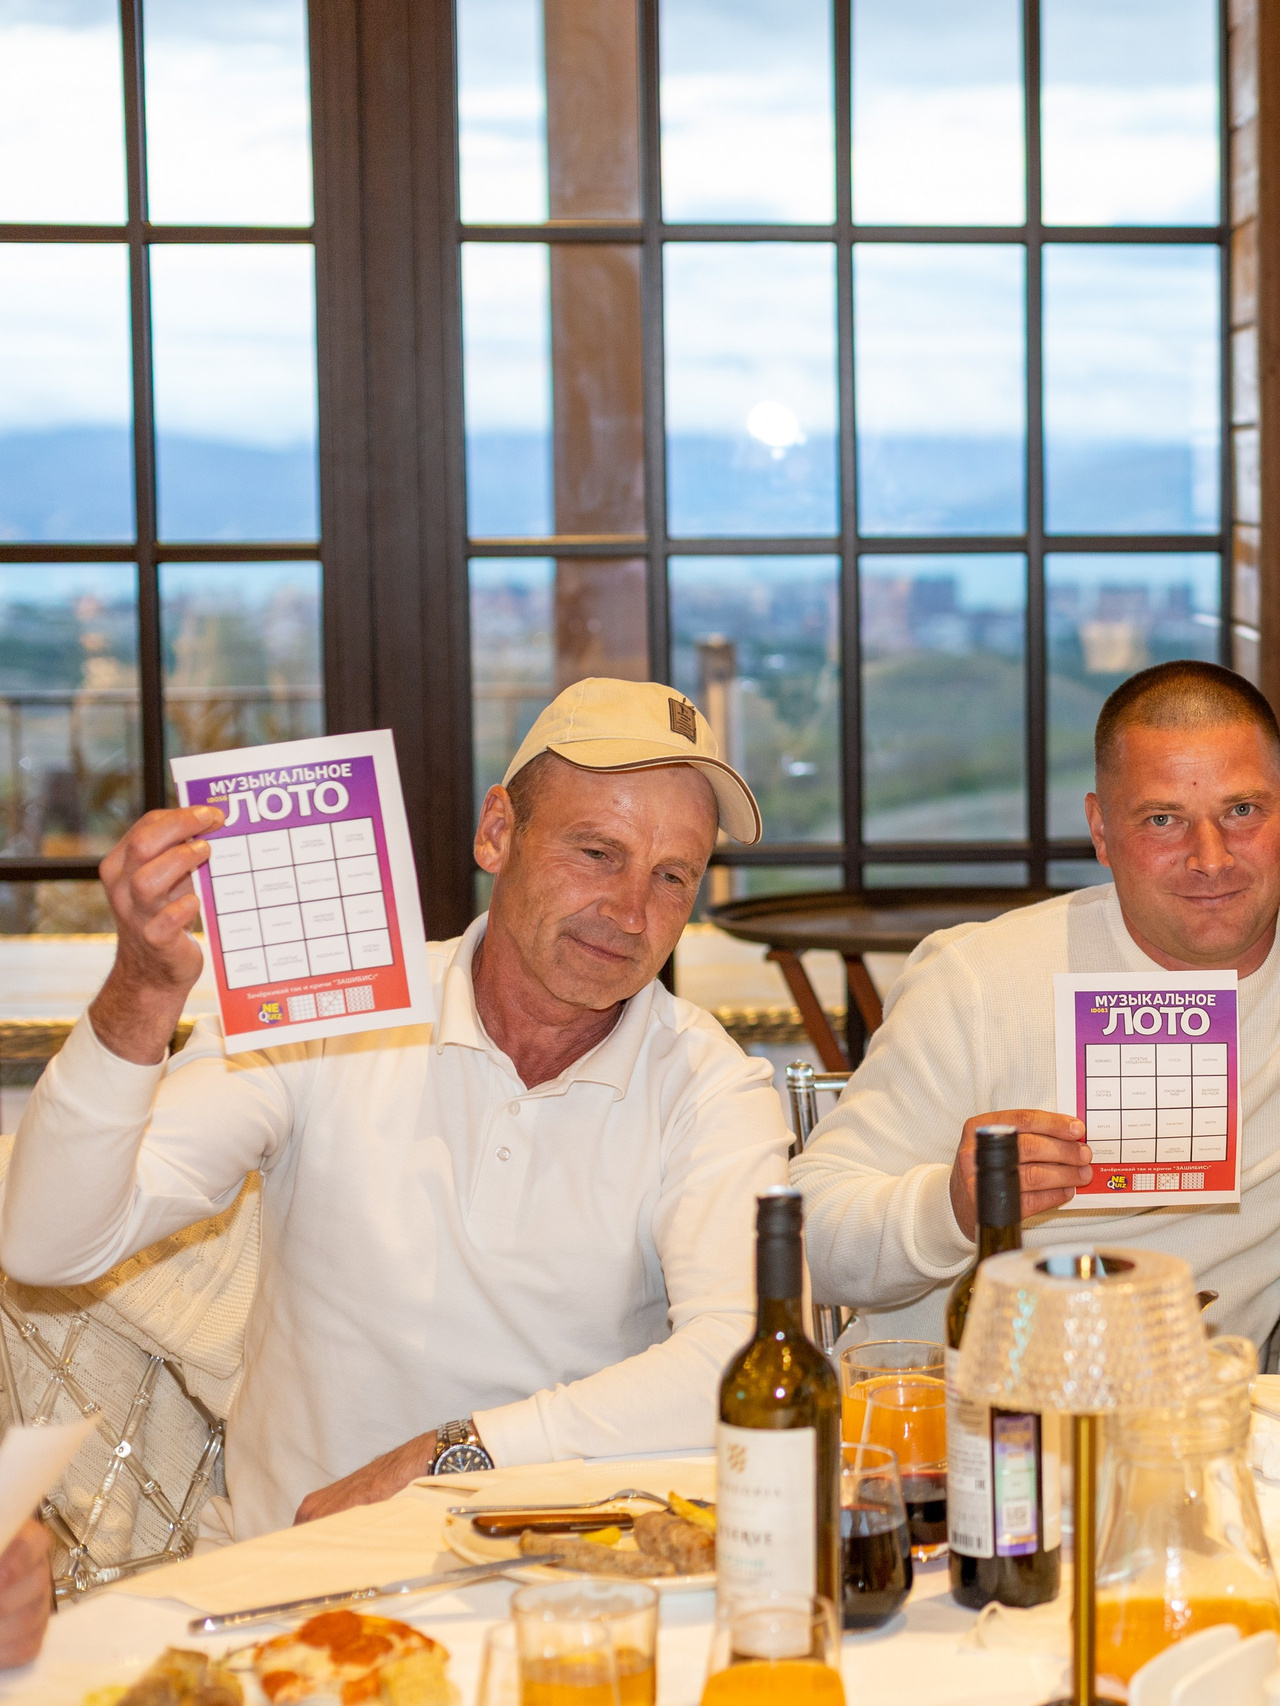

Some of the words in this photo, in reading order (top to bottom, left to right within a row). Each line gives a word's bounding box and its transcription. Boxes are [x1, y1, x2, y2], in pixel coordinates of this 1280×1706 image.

[209, 763, 352, 796] МУЗЫКАЛЬНОЕ
[224, 780, 350, 827] ЛОТО
[1095, 993, 1216, 1007] МУЗЫКАЛЬНОЕ
[262, 1003, 279, 1014] NE
[1101, 1006, 1211, 1037] ЛОТО
[1107, 1181, 1127, 1189] QUIZ
[1111, 1176, 1126, 1184] NE
